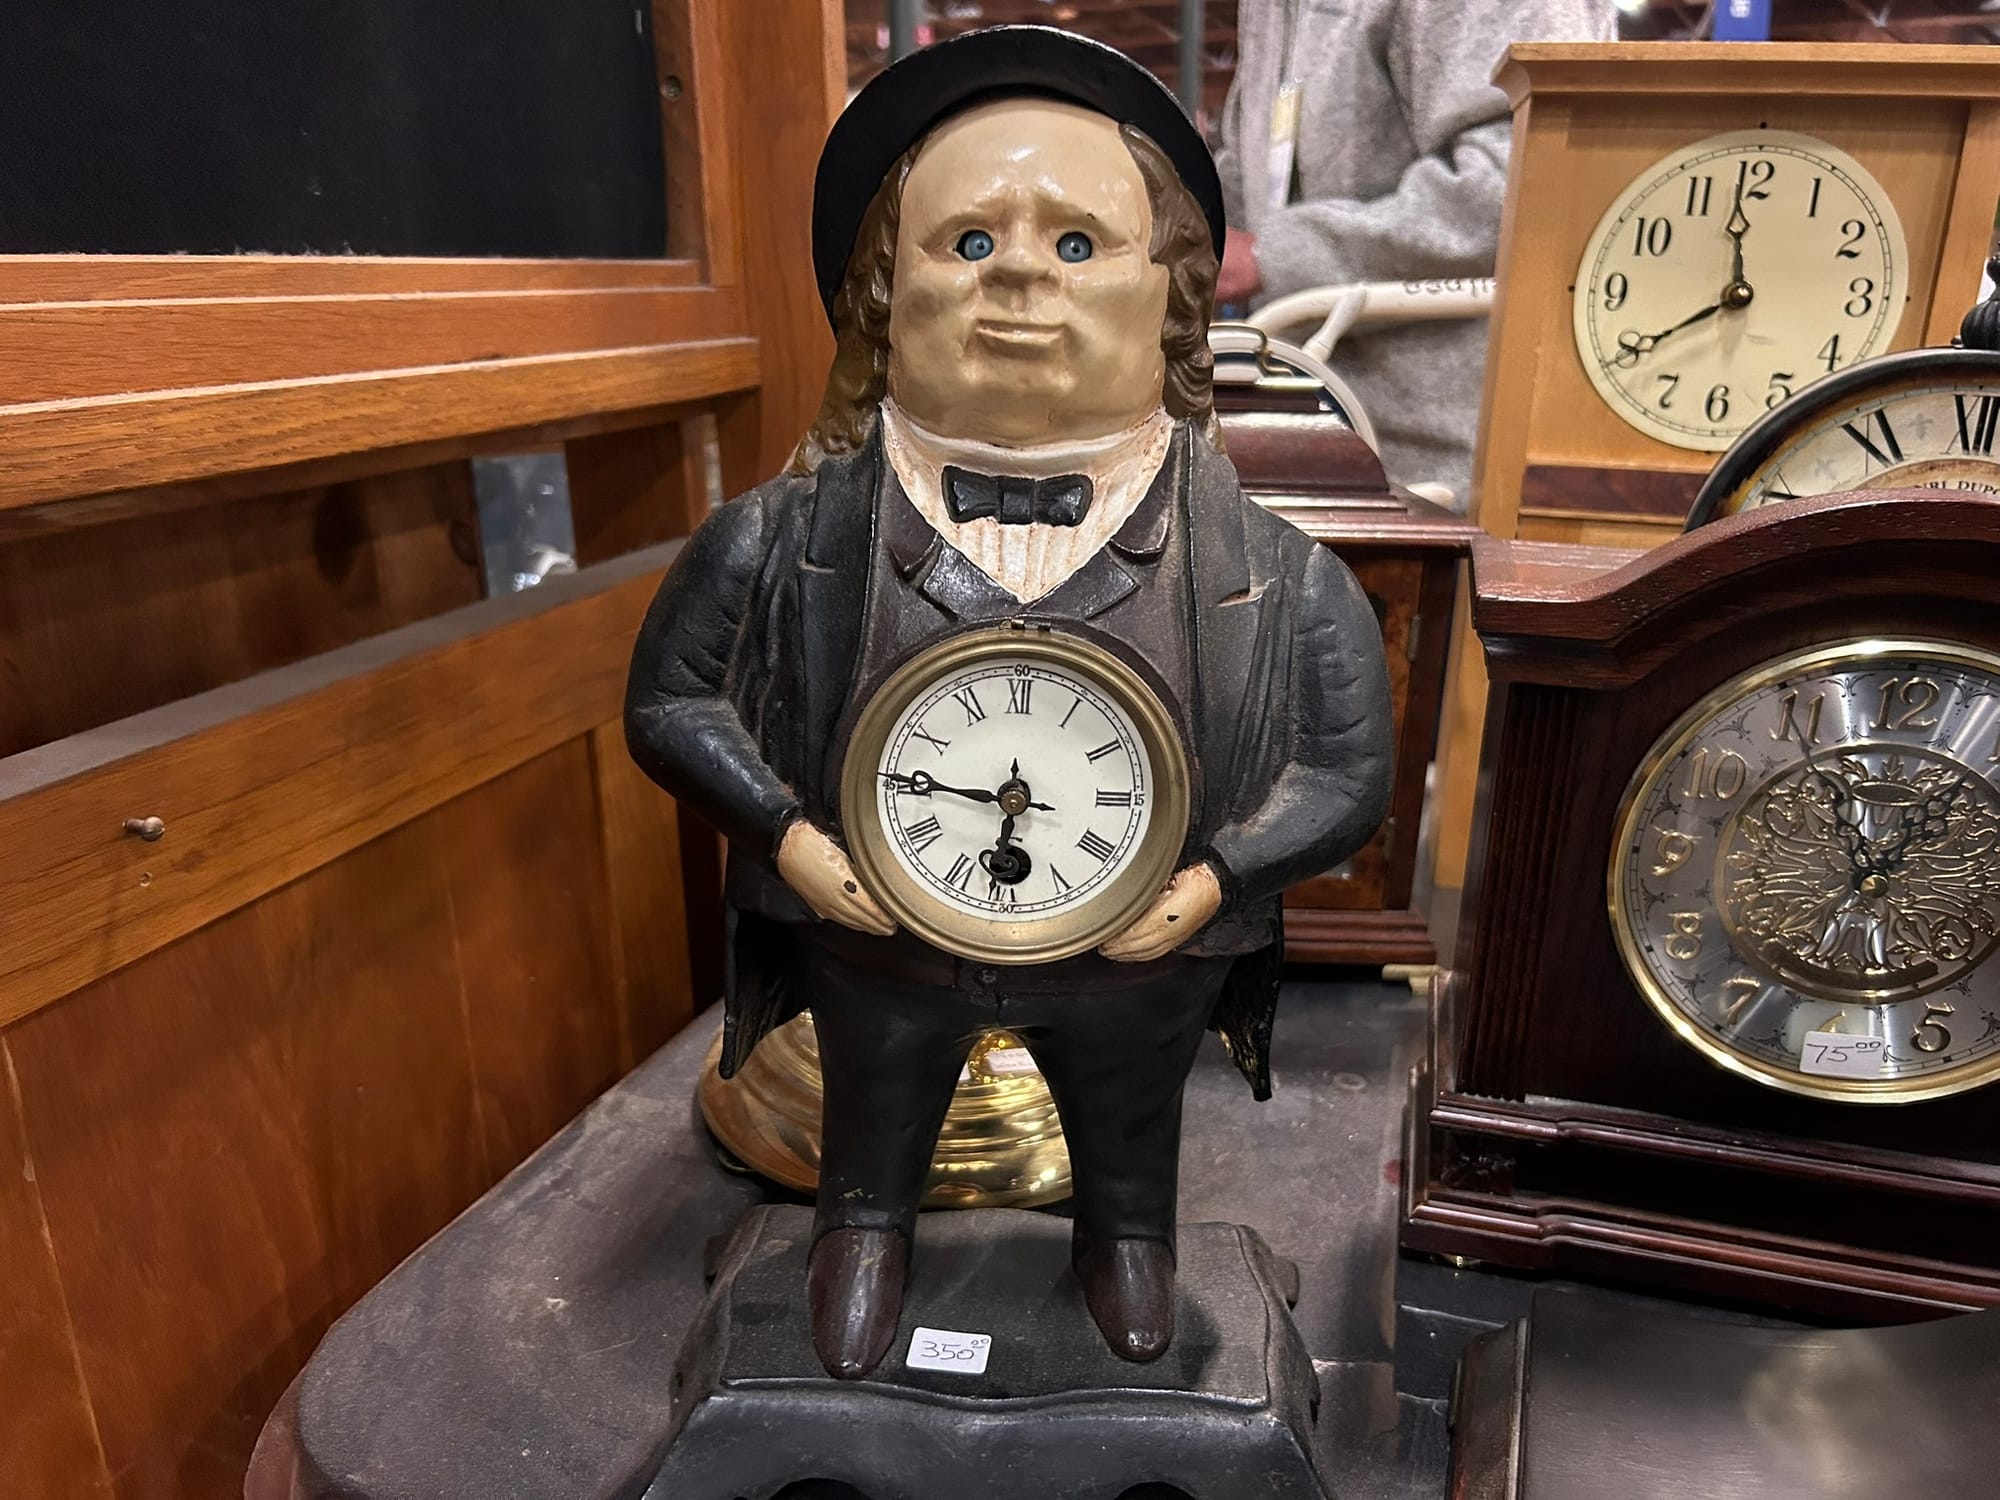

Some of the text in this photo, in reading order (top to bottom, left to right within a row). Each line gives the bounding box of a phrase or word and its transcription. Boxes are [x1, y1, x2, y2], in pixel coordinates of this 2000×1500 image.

[1686, 176, 1712, 216] 11
[1808, 178, 1822, 218] 1
[1633, 217, 1672, 257] 10
[1835, 220, 1866, 259] 2
[1604, 272, 1628, 311] 9
[1844, 277, 1874, 318] 3
[1615, 330, 1641, 369] 8
[1817, 334, 1842, 372] 4
[1657, 373, 1680, 409] 7
[1705, 384, 1730, 423] 6
[1765, 372, 1795, 410] 5
[1839, 405, 1909, 476] XI
[1939, 393, 2000, 457] XII
[1014, 665, 1031, 677] 60
[952, 685, 988, 727] XI
[1004, 678, 1035, 715] XII
[1770, 689, 1827, 744] 11
[1870, 676, 1940, 731] 12
[911, 723, 952, 755] X
[1682, 747, 1746, 800] 10
[1134, 793, 1146, 806] 15
[1651, 829, 1694, 877] 9
[999, 903, 1014, 914] 30
[1664, 913, 1702, 960] 8
[1720, 976, 1760, 1027] 7
[1911, 1000, 1956, 1053] 5
